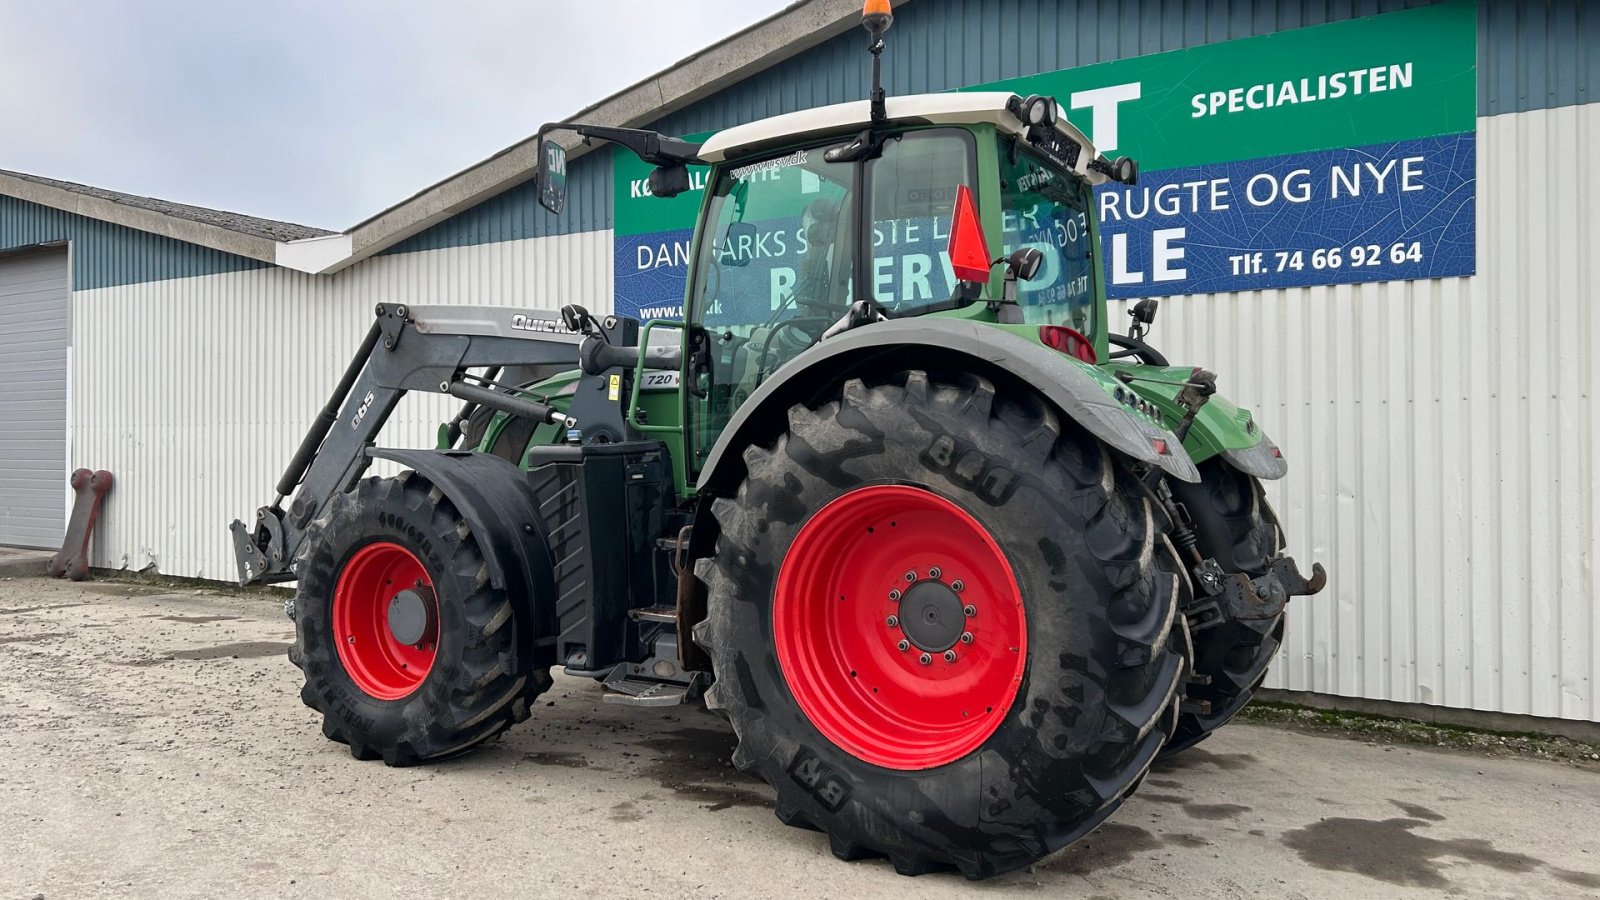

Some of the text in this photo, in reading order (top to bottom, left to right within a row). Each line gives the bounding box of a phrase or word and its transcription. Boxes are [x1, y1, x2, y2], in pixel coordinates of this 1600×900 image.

[1191, 62, 1413, 118] SPECIALISTEN
[637, 231, 786, 270] DANARKS
[1100, 177, 1230, 222] RUGTE
[1246, 168, 1311, 207] OG
[1332, 156, 1424, 199] NYE
[1229, 242, 1423, 276] Tlf. 74 66 92 64
[511, 313, 578, 335] Quick
[647, 374, 673, 386] 720
